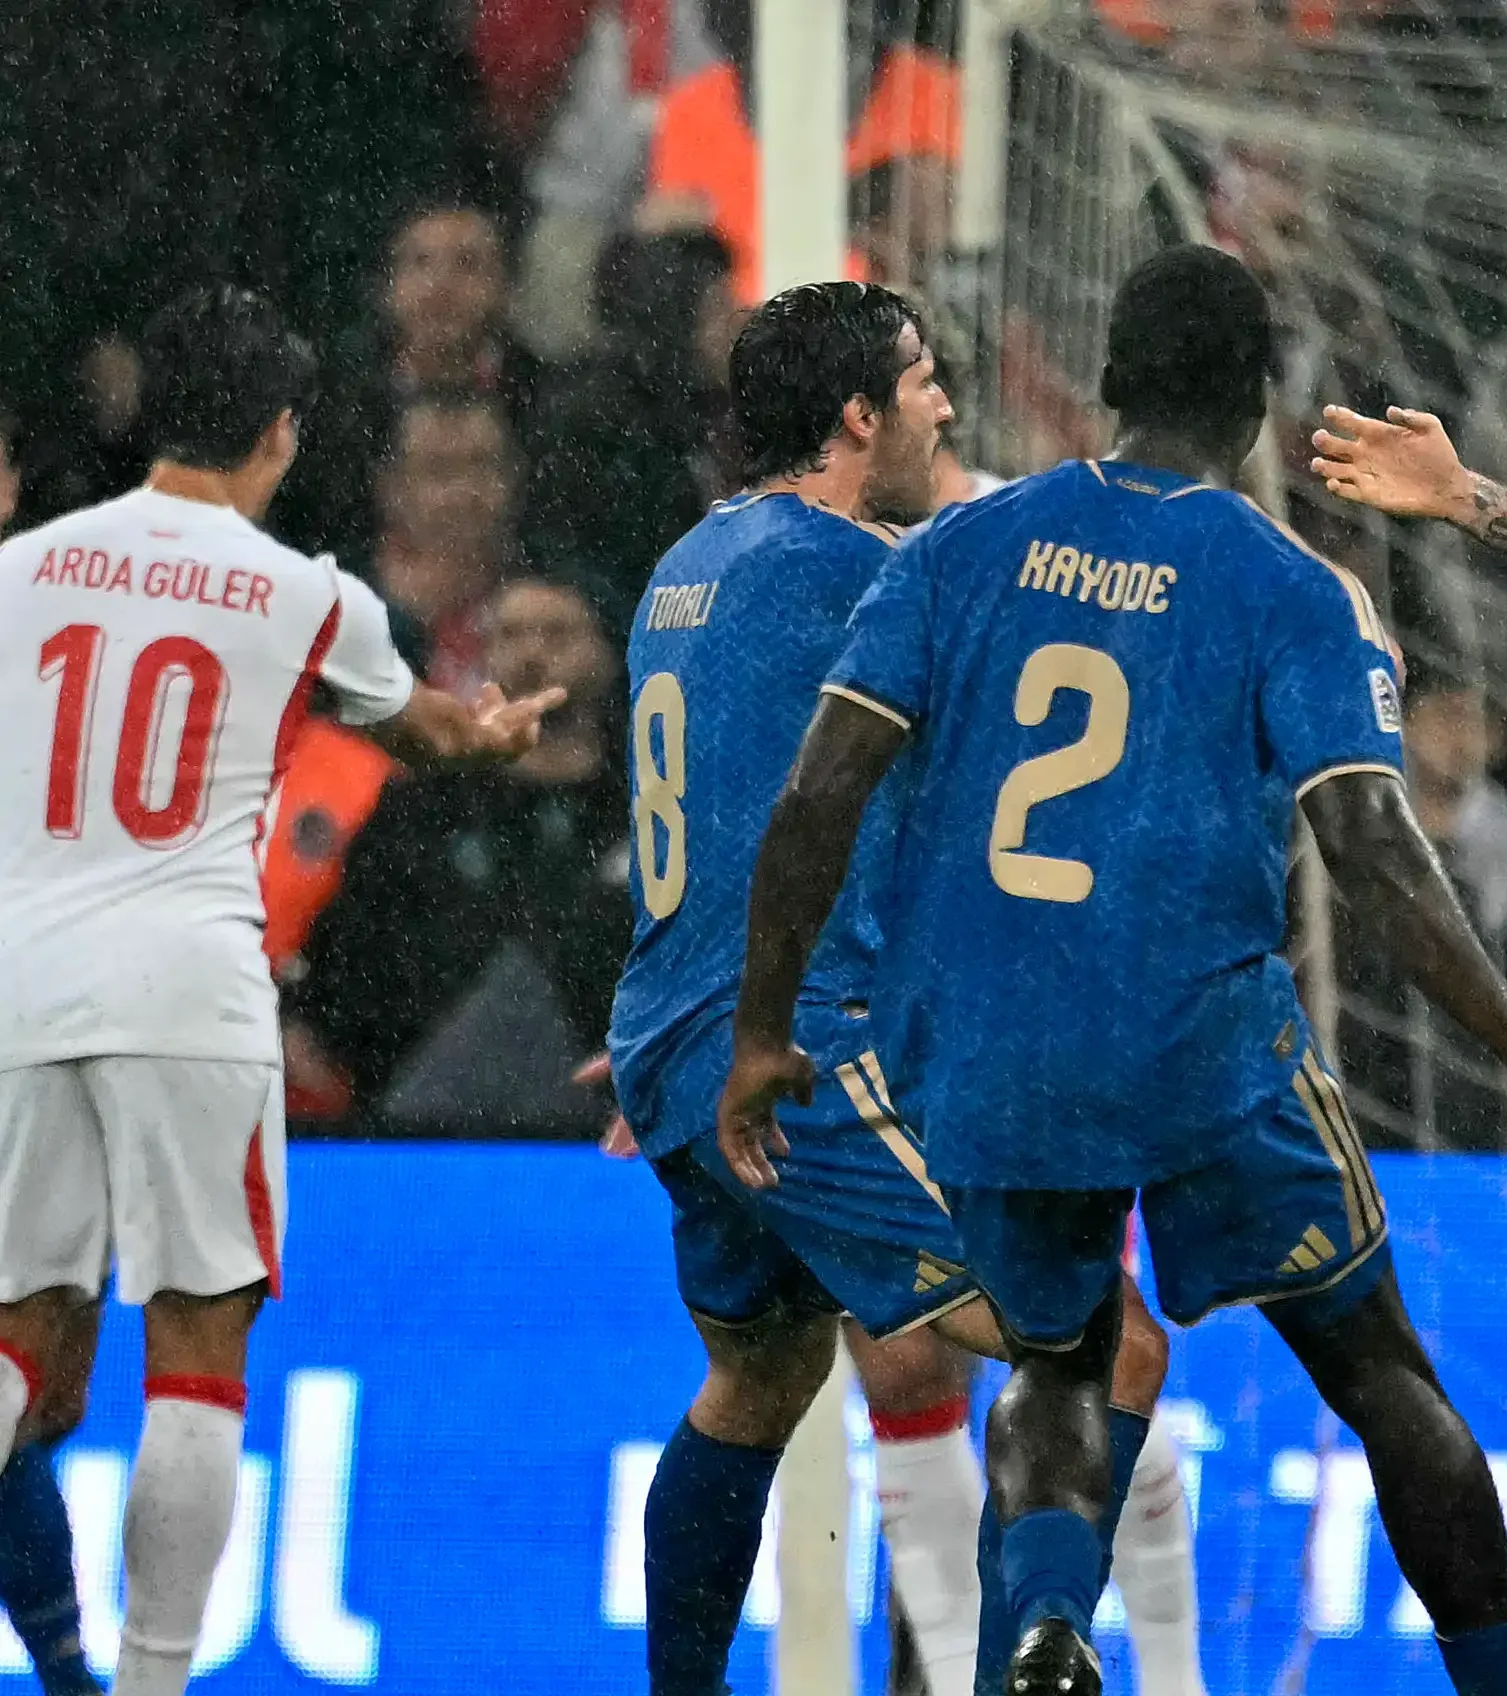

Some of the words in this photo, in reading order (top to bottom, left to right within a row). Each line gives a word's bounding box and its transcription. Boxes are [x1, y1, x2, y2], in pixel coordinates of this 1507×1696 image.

[33, 547, 133, 595] ARDA
[143, 558, 275, 618] GÜLER
[646, 580, 719, 631] TONALI
[1018, 540, 1177, 613] KAYODE
[38, 623, 230, 850] 10
[633, 672, 687, 920] 8
[989, 643, 1130, 903] 2
